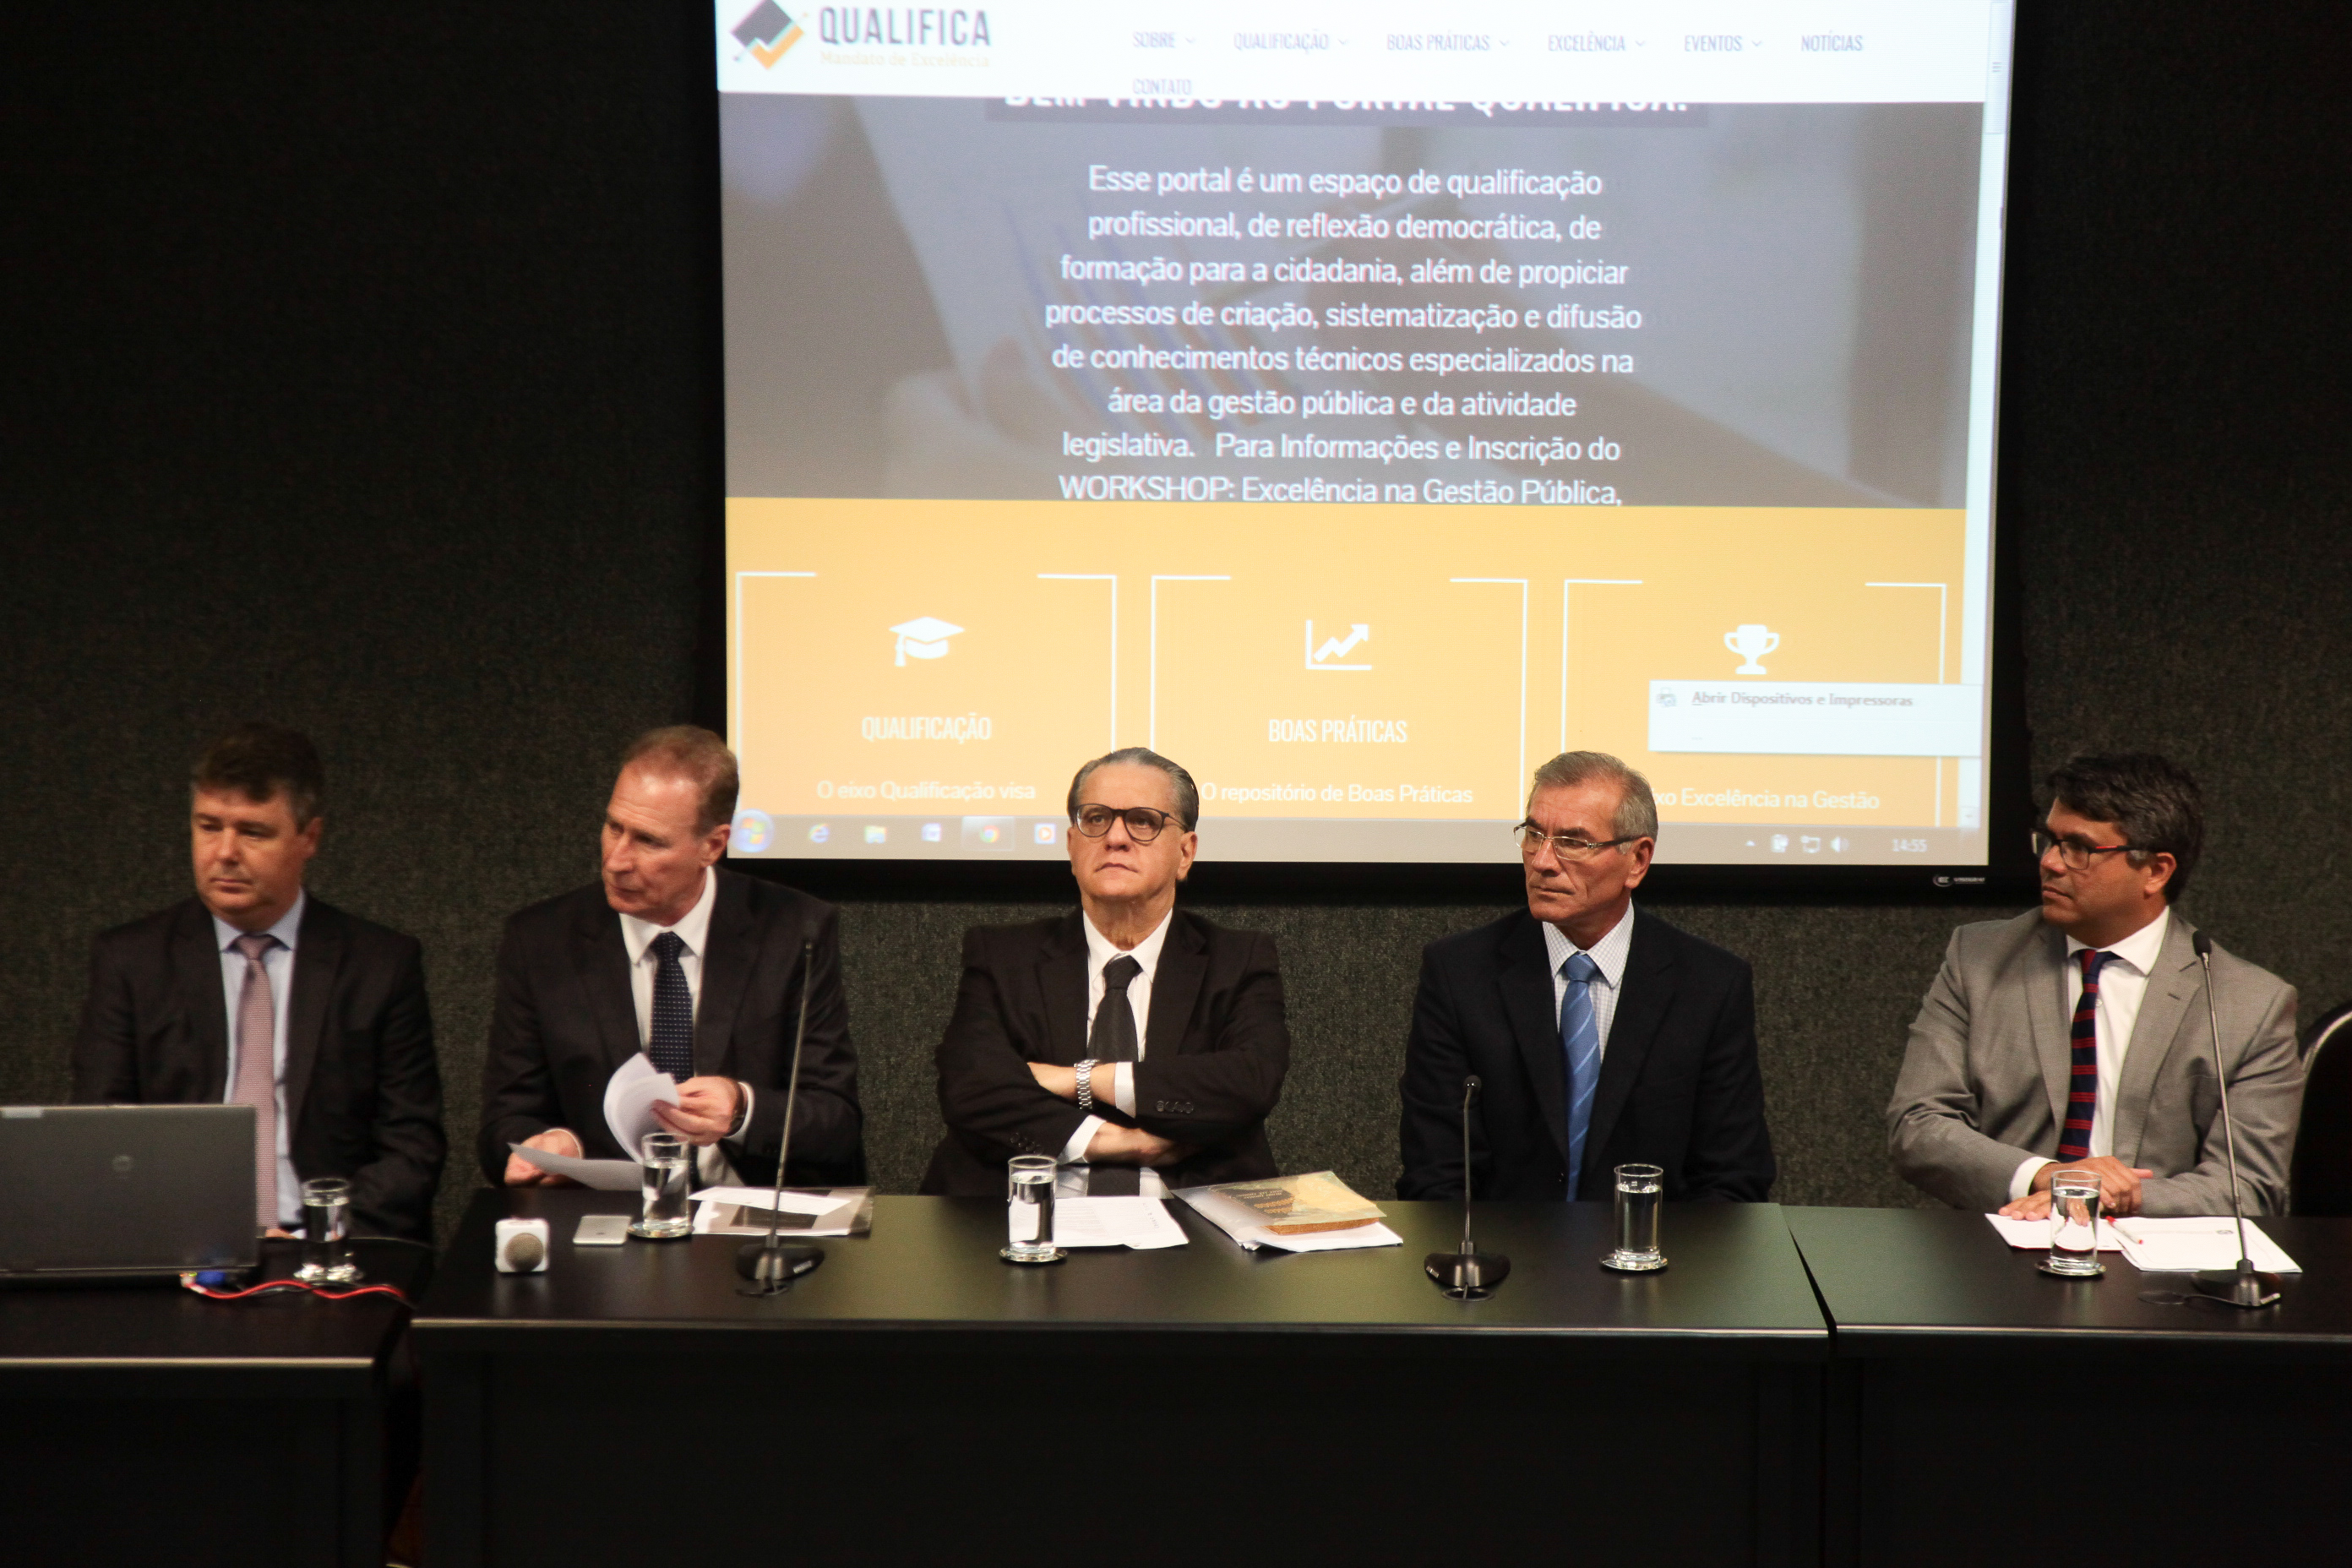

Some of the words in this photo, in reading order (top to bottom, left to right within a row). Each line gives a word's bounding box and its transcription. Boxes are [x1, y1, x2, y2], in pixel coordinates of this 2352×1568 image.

[819, 6, 992, 46] QUALIFICA
[1133, 32, 1175, 49] SOBRE
[1234, 29, 1330, 55] QUALIFICAÇÃO
[1386, 34, 1424, 52] BOAS
[1427, 30, 1490, 52] PRÁTICAS
[1548, 31, 1626, 52] EXCELÊNCIA
[1684, 35, 1743, 52] EVENTOS
[1801, 30, 1864, 52] NOTÍCIAS
[1134, 79, 1191, 95] CONTATO
[1090, 165, 1152, 191] Esse
[1158, 167, 1231, 195] portal
[1237, 167, 1254, 192] é
[1260, 173, 1302, 192] um
[1309, 173, 1402, 199] espaço
[1408, 169, 1441, 194] de
[1447, 169, 1602, 200] qualificação
[1089, 210, 1241, 239] profissional,
[1248, 212, 1281, 237] de
[1287, 212, 1390, 238] reflexão
[1396, 212, 1562, 242] democrática,
[1570, 215, 1602, 239] de
[1061, 254, 1184, 286] formação
[1190, 262, 1246, 286] para
[1252, 263, 1268, 281] a
[1274, 257, 1403, 285] cidadania,
[1410, 259, 1473, 283] além
[1480, 259, 1512, 284] de
[1519, 259, 1629, 288] propiciar
[1046, 302, 1176, 328] processos
[1182, 301, 1215, 325] de
[1221, 301, 1319, 332] criação,
[1326, 302, 1518, 333] sistematização
[1525, 309, 1541, 328] e
[1547, 303, 1642, 329] difusão
[1053, 344, 1085, 368] de
[1090, 345, 1289, 370] conhecimentos
[1295, 346, 1403, 371] técnicos
[1409, 347, 1595, 376] especializados
[1603, 355, 1634, 373] na
[1108, 387, 1164, 413] área
[1169, 389, 1201, 413] da
[1208, 390, 1295, 420] gestão
[1303, 390, 1394, 419] pública
[1401, 397, 1417, 415] e
[1423, 391, 1455, 416] da
[1462, 392, 1576, 416] atividade
[1064, 432, 1195, 462] legislativa.
[1217, 433, 1274, 458] Para
[1282, 433, 1440, 464] Informações
[1446, 441, 1462, 460] e
[1468, 435, 1582, 466] Inscrição
[1588, 437, 1620, 460] do
[1059, 476, 1235, 501] WORKSHOP:
[1242, 476, 1378, 504] Excelência
[1384, 484, 1417, 504] na
[1424, 479, 1514, 504] Gestão
[1522, 479, 1622, 506] Pública,
[1693, 692, 1726, 705] Abrir
[1731, 692, 1813, 706] Dispositivos
[1816, 696, 1827, 706] e
[1830, 694, 1913, 708] Impressoras
[862, 712, 992, 743] QUALIFICAÇÃO
[1269, 719, 1317, 742] BOAS
[1321, 715, 1407, 743] PRÁTICAS
[817, 781, 834, 798] O
[837, 781, 877, 798] eixo
[880, 781, 995, 801] Qualificação
[999, 782, 1036, 799] visa
[1200, 782, 1217, 800] O
[1221, 784, 1316, 803] repositório
[1320, 785, 1343, 801] de
[1348, 784, 1395, 802] Boas
[1400, 784, 1473, 803] Práticas
[1681, 787, 1780, 807] Excelência
[1784, 795, 1808, 808] na
[1812, 791, 1880, 808] Gestão
[1892, 838, 1928, 853] 14:55
